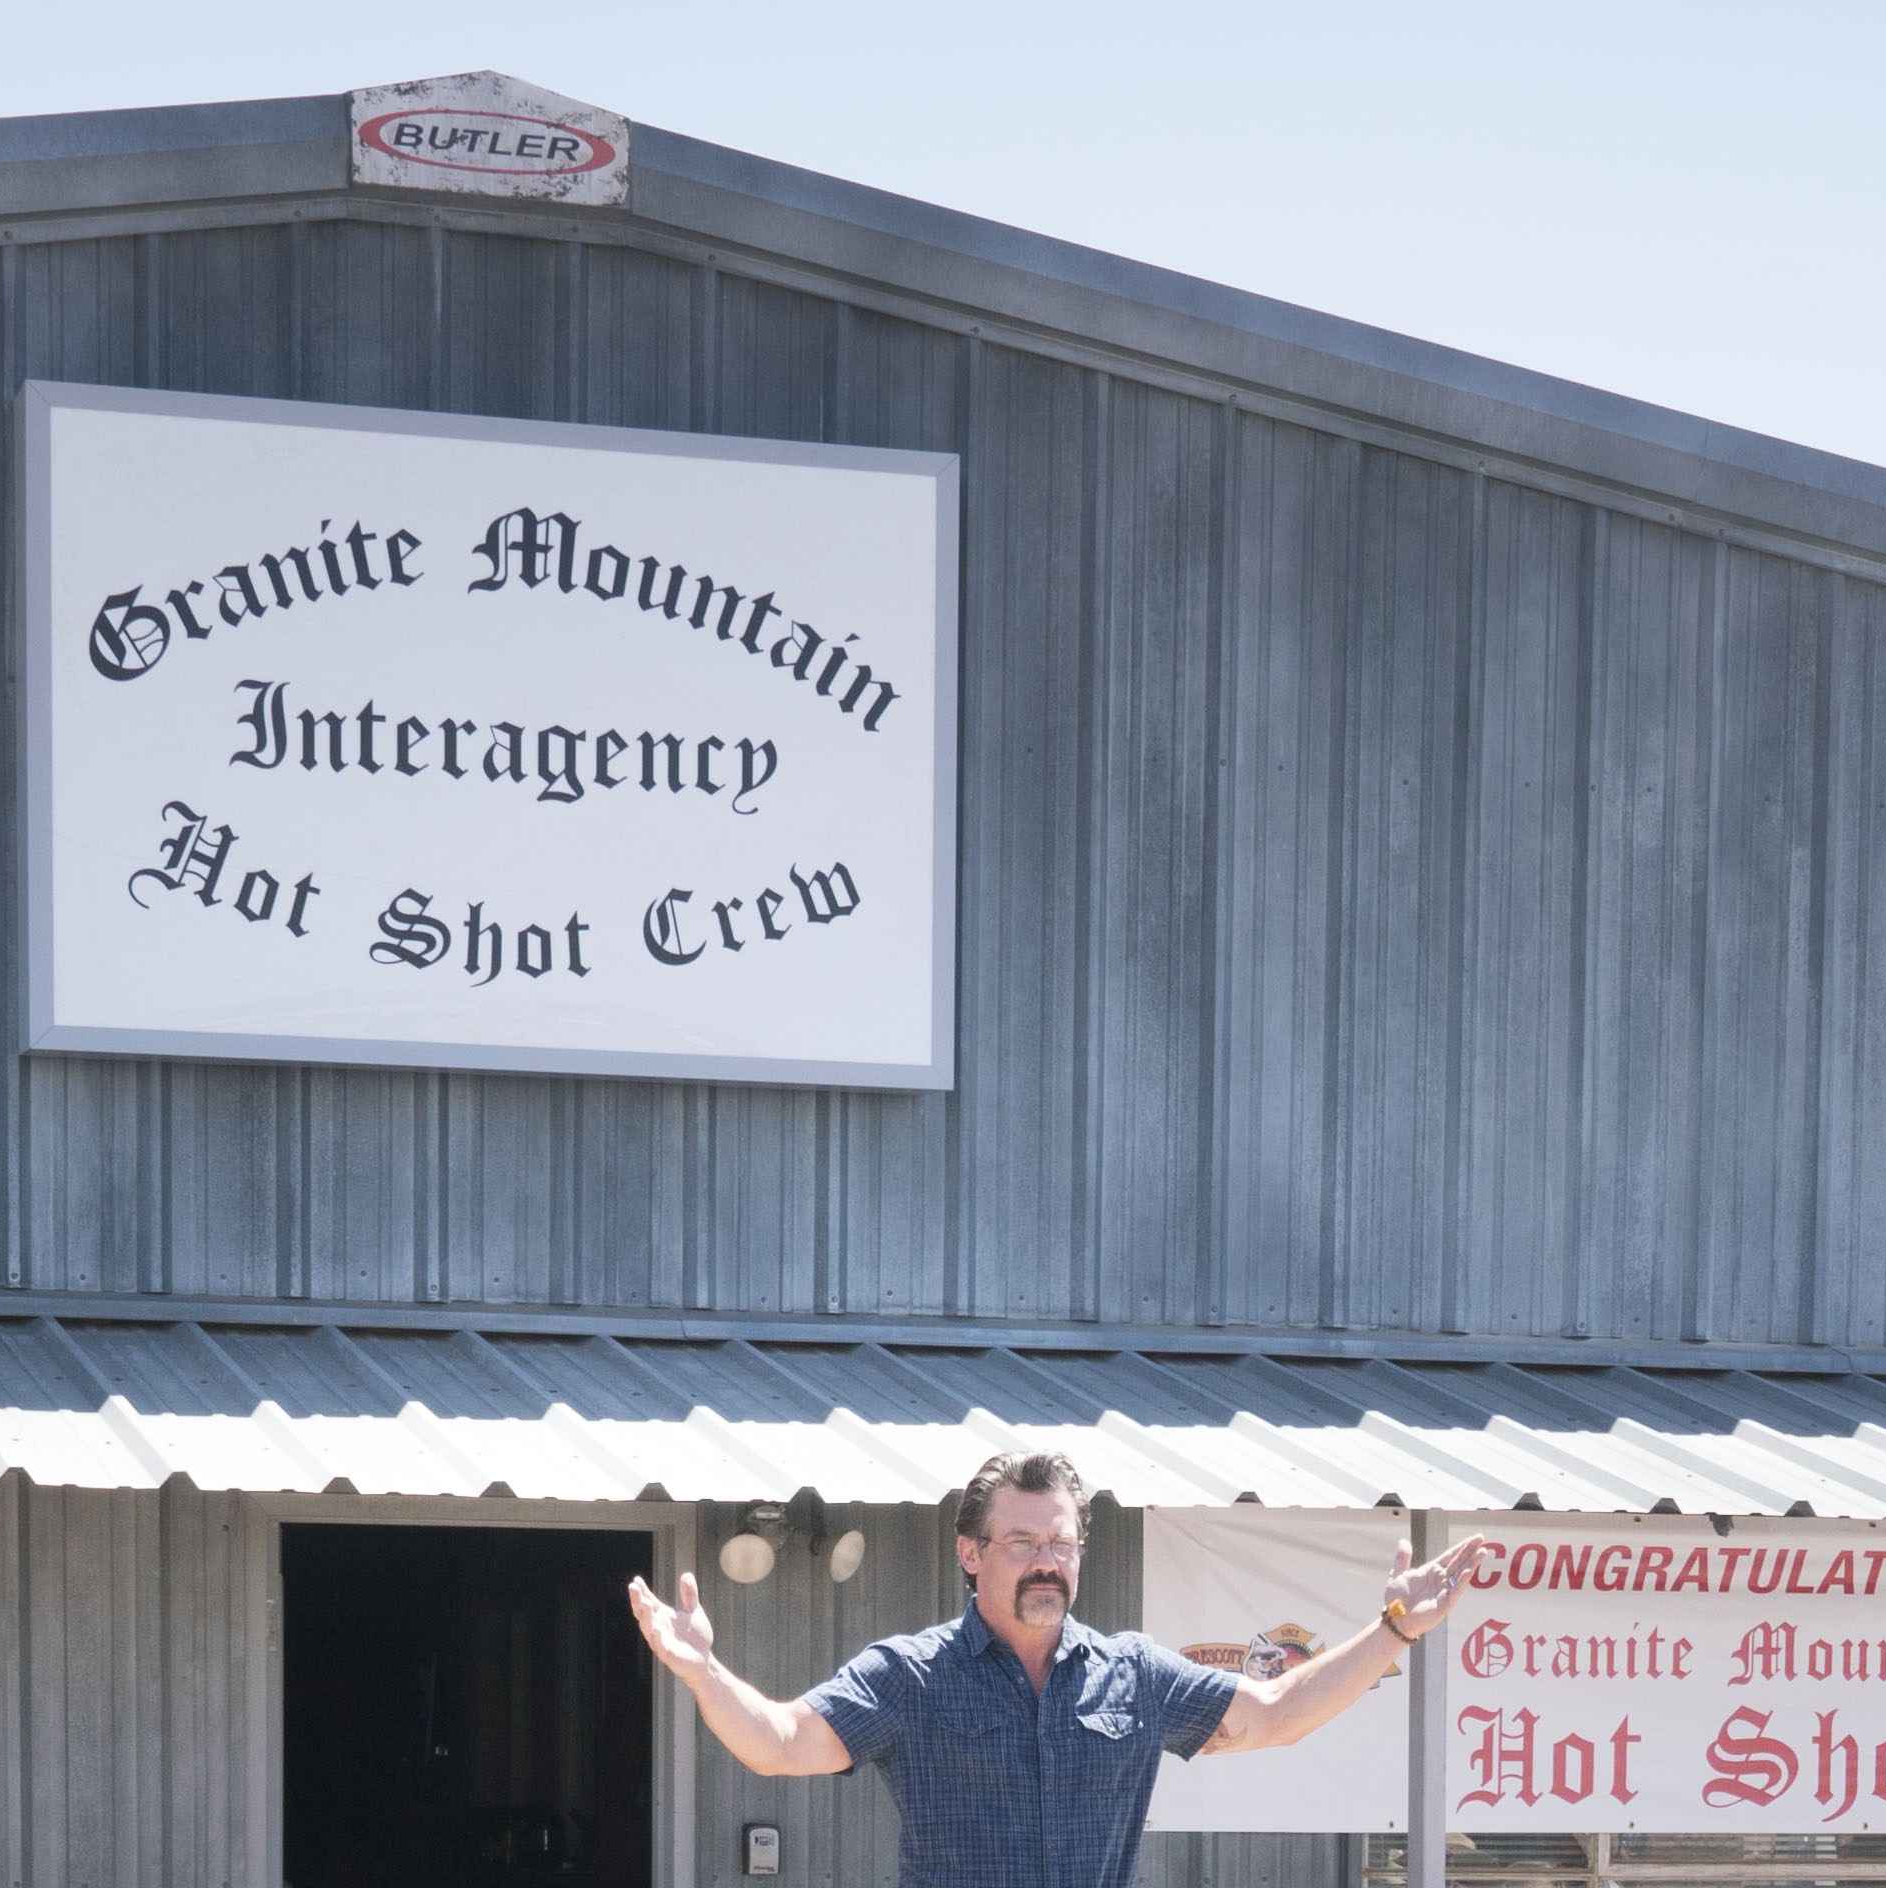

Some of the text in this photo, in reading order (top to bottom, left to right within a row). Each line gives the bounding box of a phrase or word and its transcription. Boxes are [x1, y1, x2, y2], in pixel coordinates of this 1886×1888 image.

[392, 122, 581, 162] BUTLER
[88, 506, 902, 733] Granite Mountain
[229, 678, 779, 816] Interagency
[128, 799, 862, 988] Hot Shot Crew
[1460, 1617, 1695, 1681] Granite
[1456, 1704, 1643, 1813] Hot
